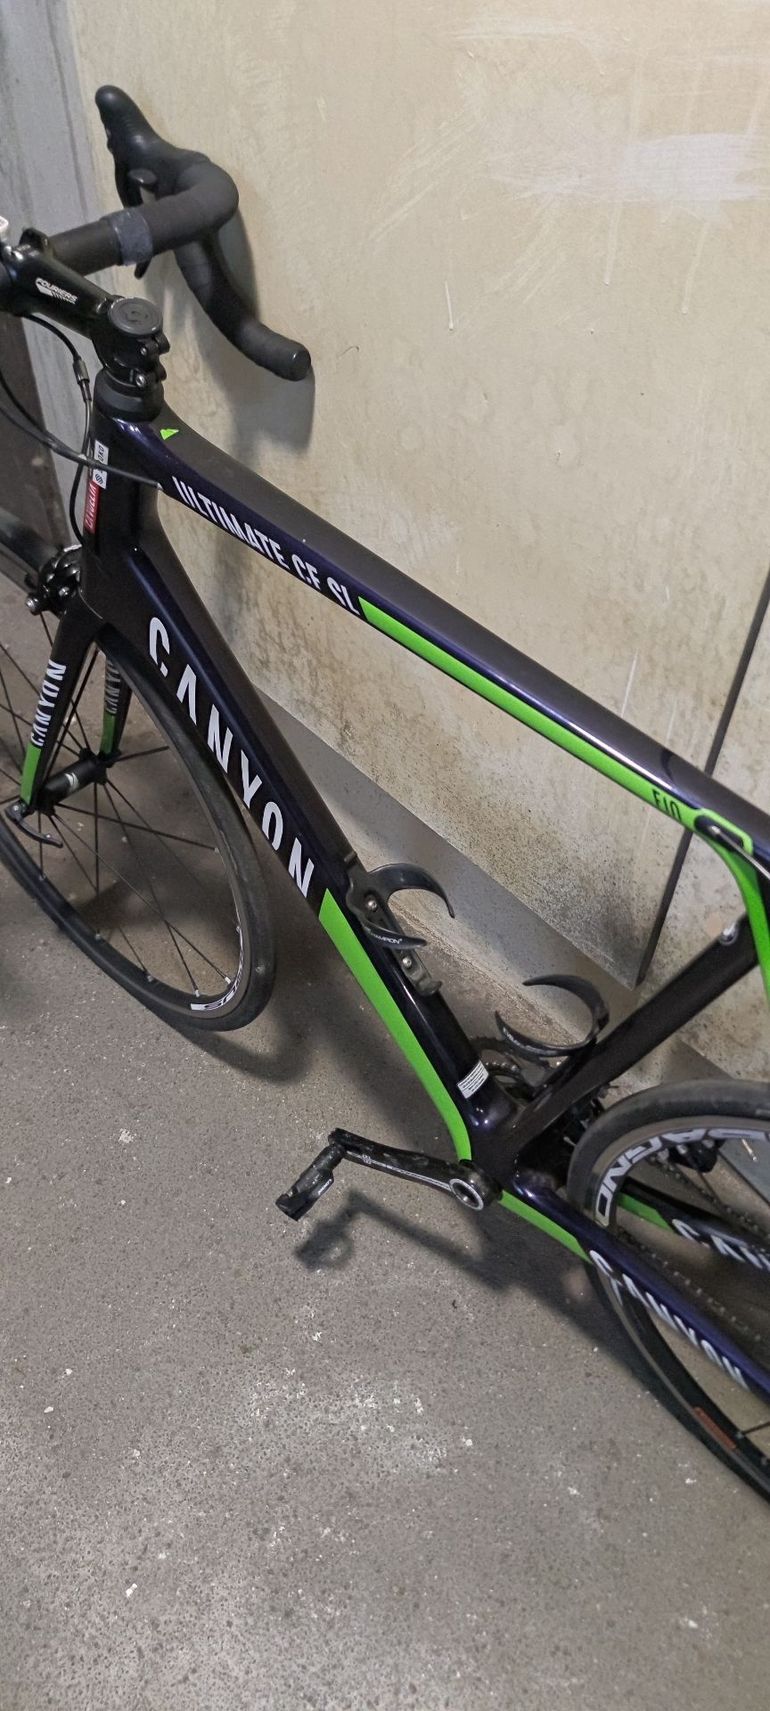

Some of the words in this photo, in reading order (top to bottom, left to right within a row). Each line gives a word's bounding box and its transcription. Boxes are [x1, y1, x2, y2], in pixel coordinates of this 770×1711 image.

[172, 476, 290, 570] ULTIMATE
[292, 554, 321, 590] CF
[327, 576, 360, 615] SL
[30, 659, 67, 747] CANYON
[149, 617, 315, 898] CANYON
[589, 1250, 750, 1392] CANYON
